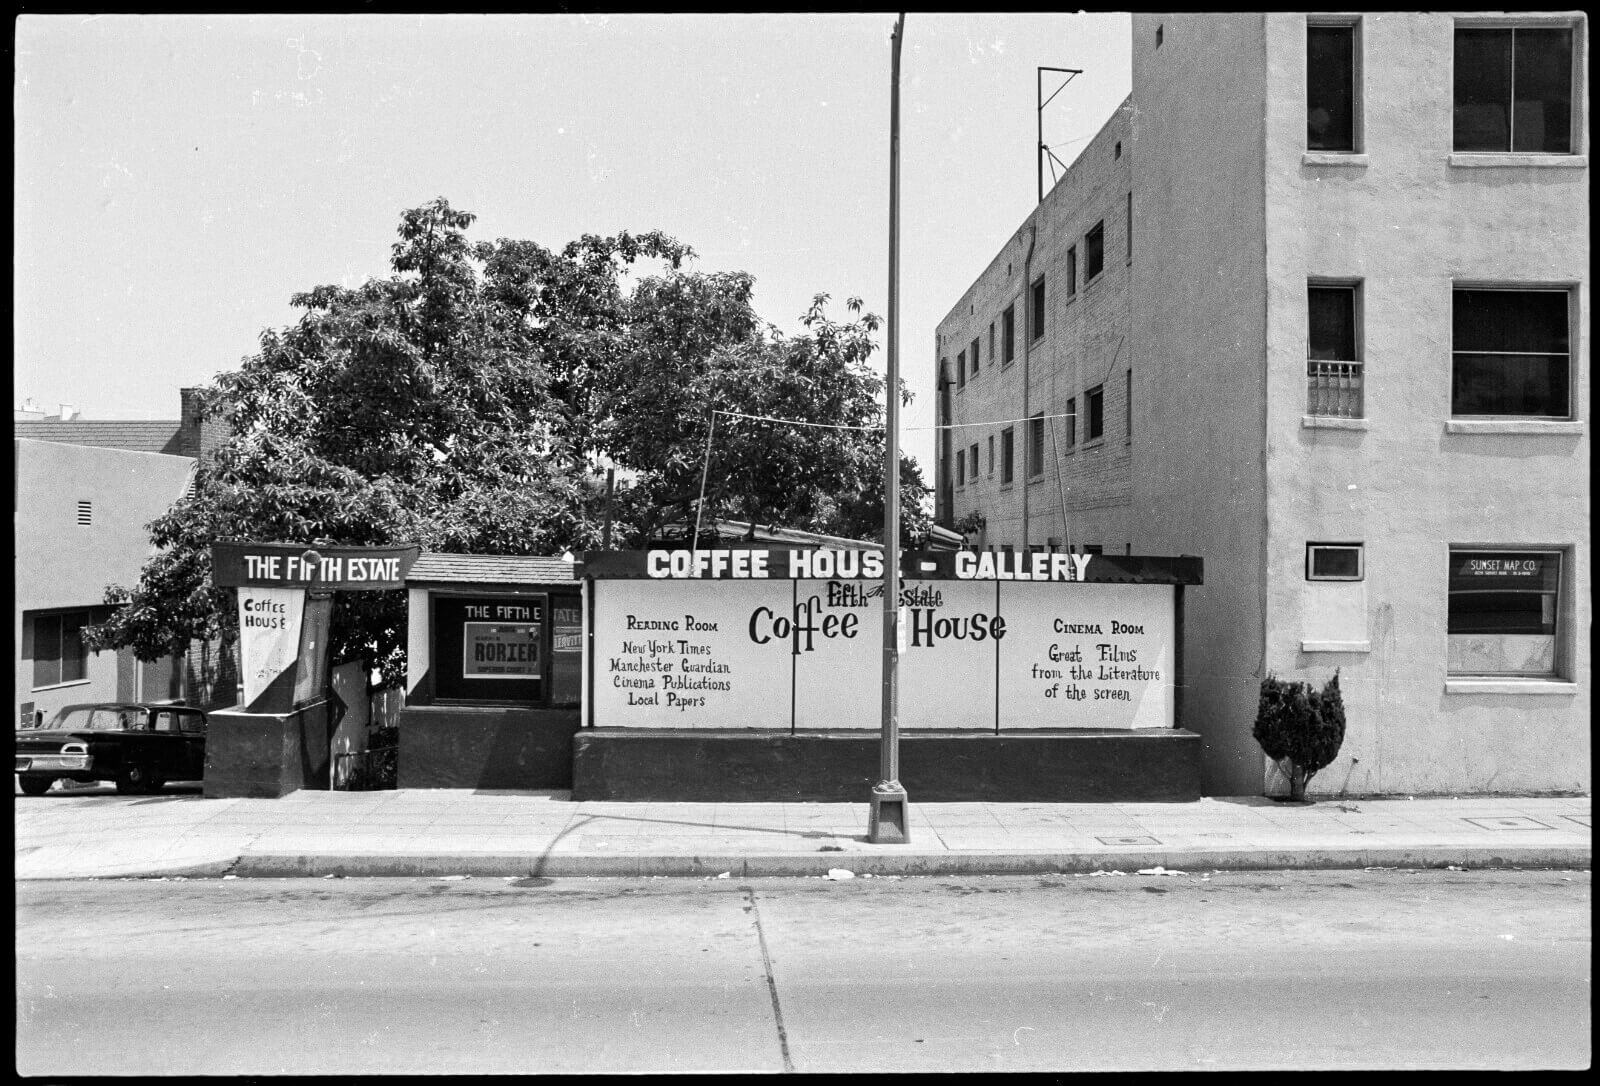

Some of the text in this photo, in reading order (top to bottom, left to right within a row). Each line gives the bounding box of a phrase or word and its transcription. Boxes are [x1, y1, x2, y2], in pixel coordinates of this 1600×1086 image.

[244, 556, 281, 579] THE
[348, 558, 400, 581] ESTATE
[647, 549, 769, 578] COFFEE
[788, 550, 902, 579] HOUS
[954, 551, 1093, 581] GALLERY
[1470, 559, 1537, 570] SUNSET MAP CO.
[826, 580, 868, 607] Fifth
[464, 605, 491, 619] THE
[496, 606, 531, 621] FIFTH
[748, 595, 859, 655] Coffee
[910, 607, 1007, 647] House
[622, 640, 710, 659] New York Times
[1049, 644, 1137, 662] Great Films
[610, 654, 730, 673] Manchester Guardian
[1032, 664, 1159, 680] from the Literature
[614, 675, 730, 691] Cinema Publications
[1045, 683, 1131, 702] of the screen
[628, 692, 704, 711] Local Papers
